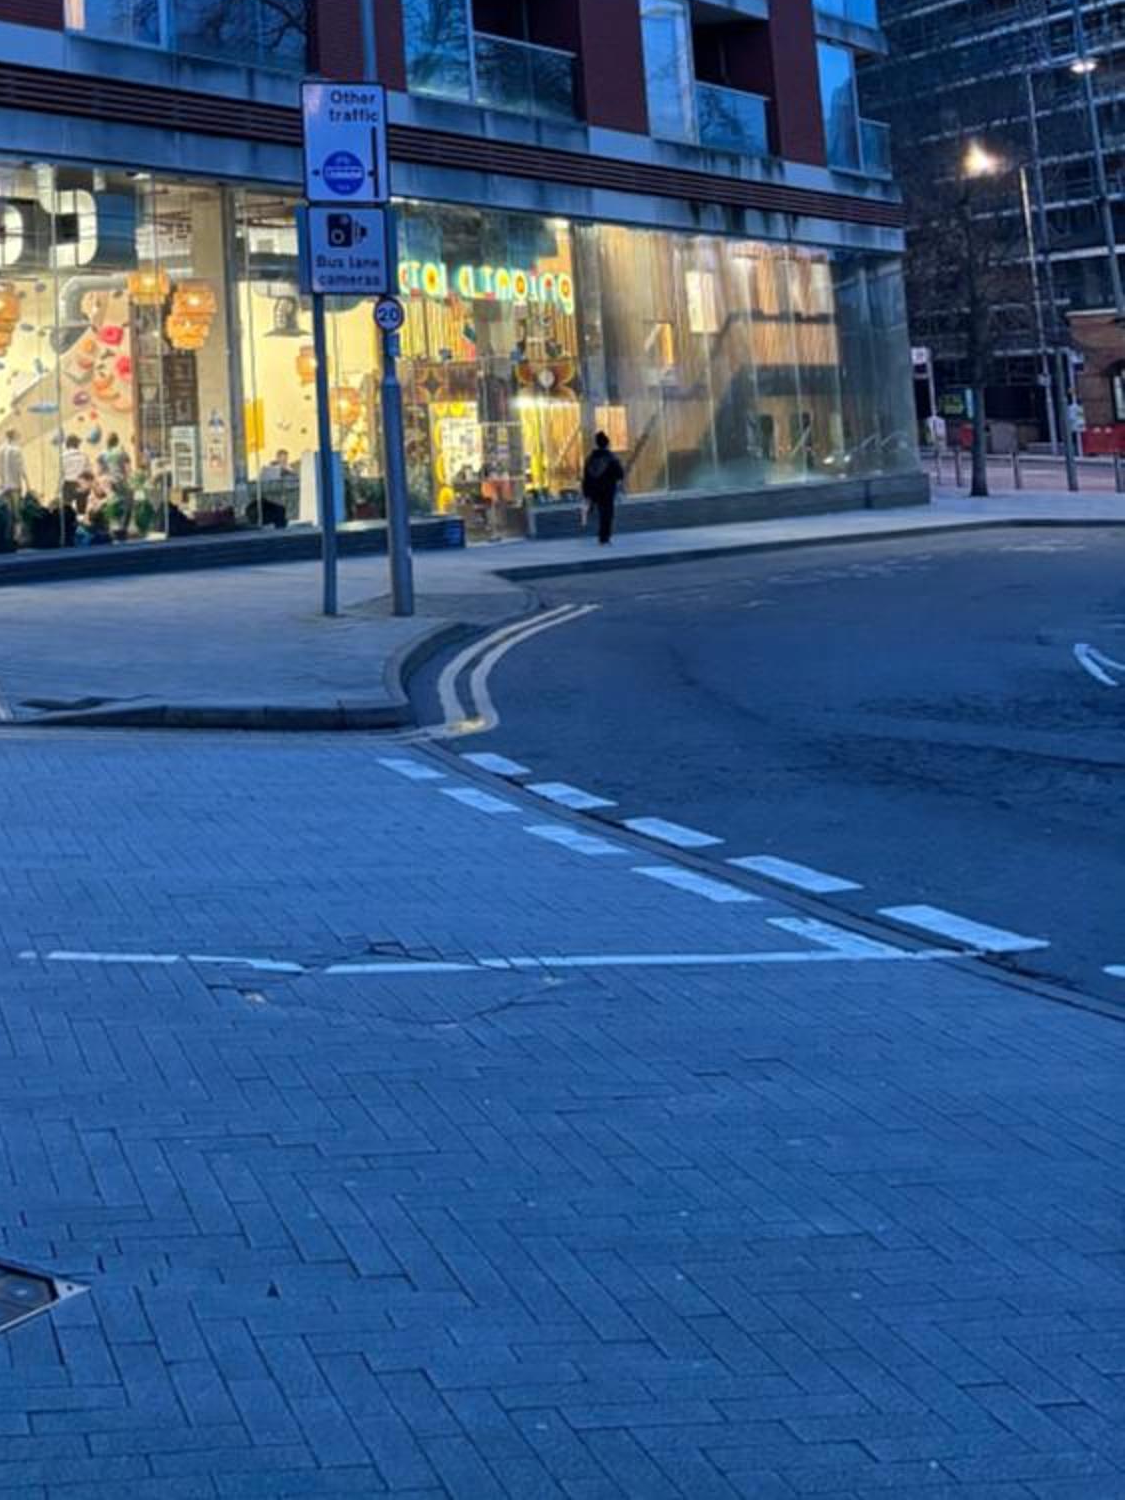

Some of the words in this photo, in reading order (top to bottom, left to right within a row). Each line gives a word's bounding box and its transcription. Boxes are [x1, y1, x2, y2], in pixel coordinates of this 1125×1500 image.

[330, 89, 376, 104] Other
[328, 107, 379, 122] traffic
[316, 254, 344, 269] Bus
[348, 254, 380, 269] lane
[317, 275, 380, 287] cameras
[378, 307, 400, 322] 20
